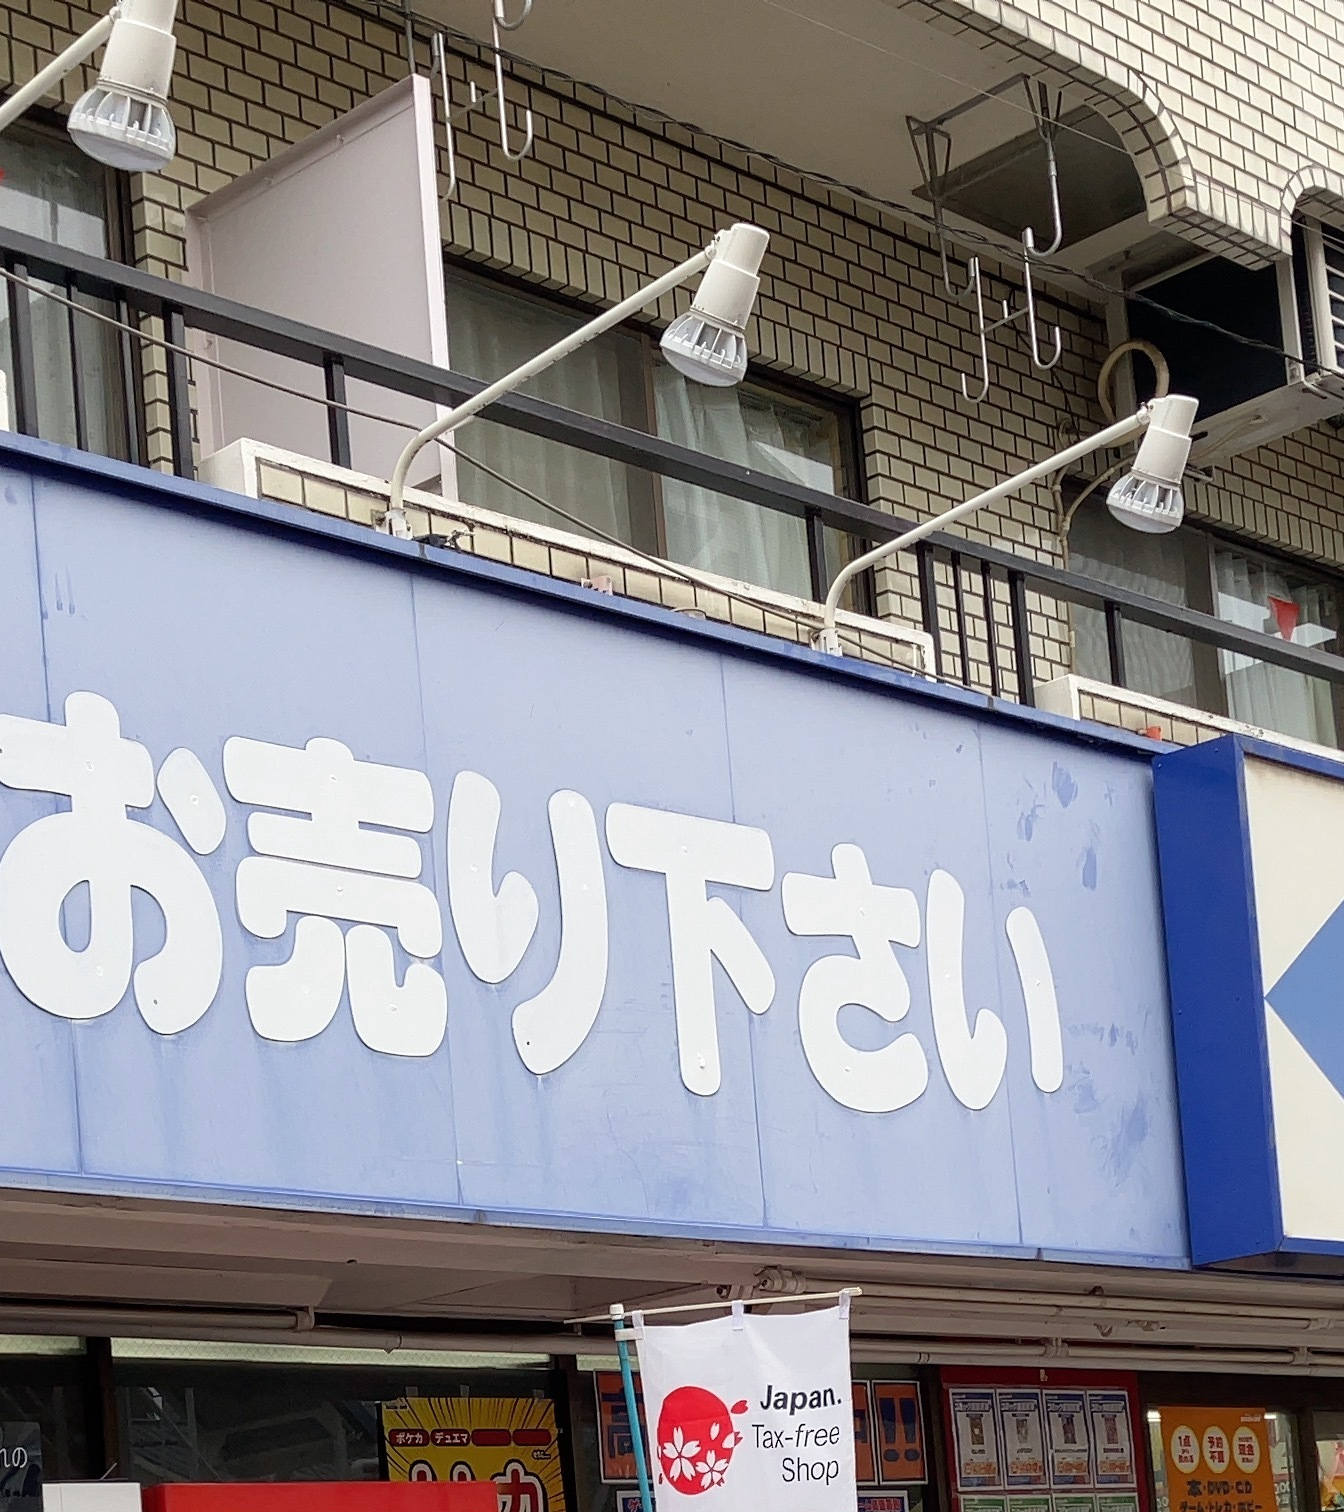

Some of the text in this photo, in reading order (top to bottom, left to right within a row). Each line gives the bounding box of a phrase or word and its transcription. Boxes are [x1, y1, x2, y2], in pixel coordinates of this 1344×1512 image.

[760, 1384, 843, 1415] Japan.
[396, 1432, 423, 1444] ポケカ
[435, 1432, 469, 1444] デュエマ
[751, 1424, 841, 1449] Tax-free
[782, 1457, 840, 1486] Shop
